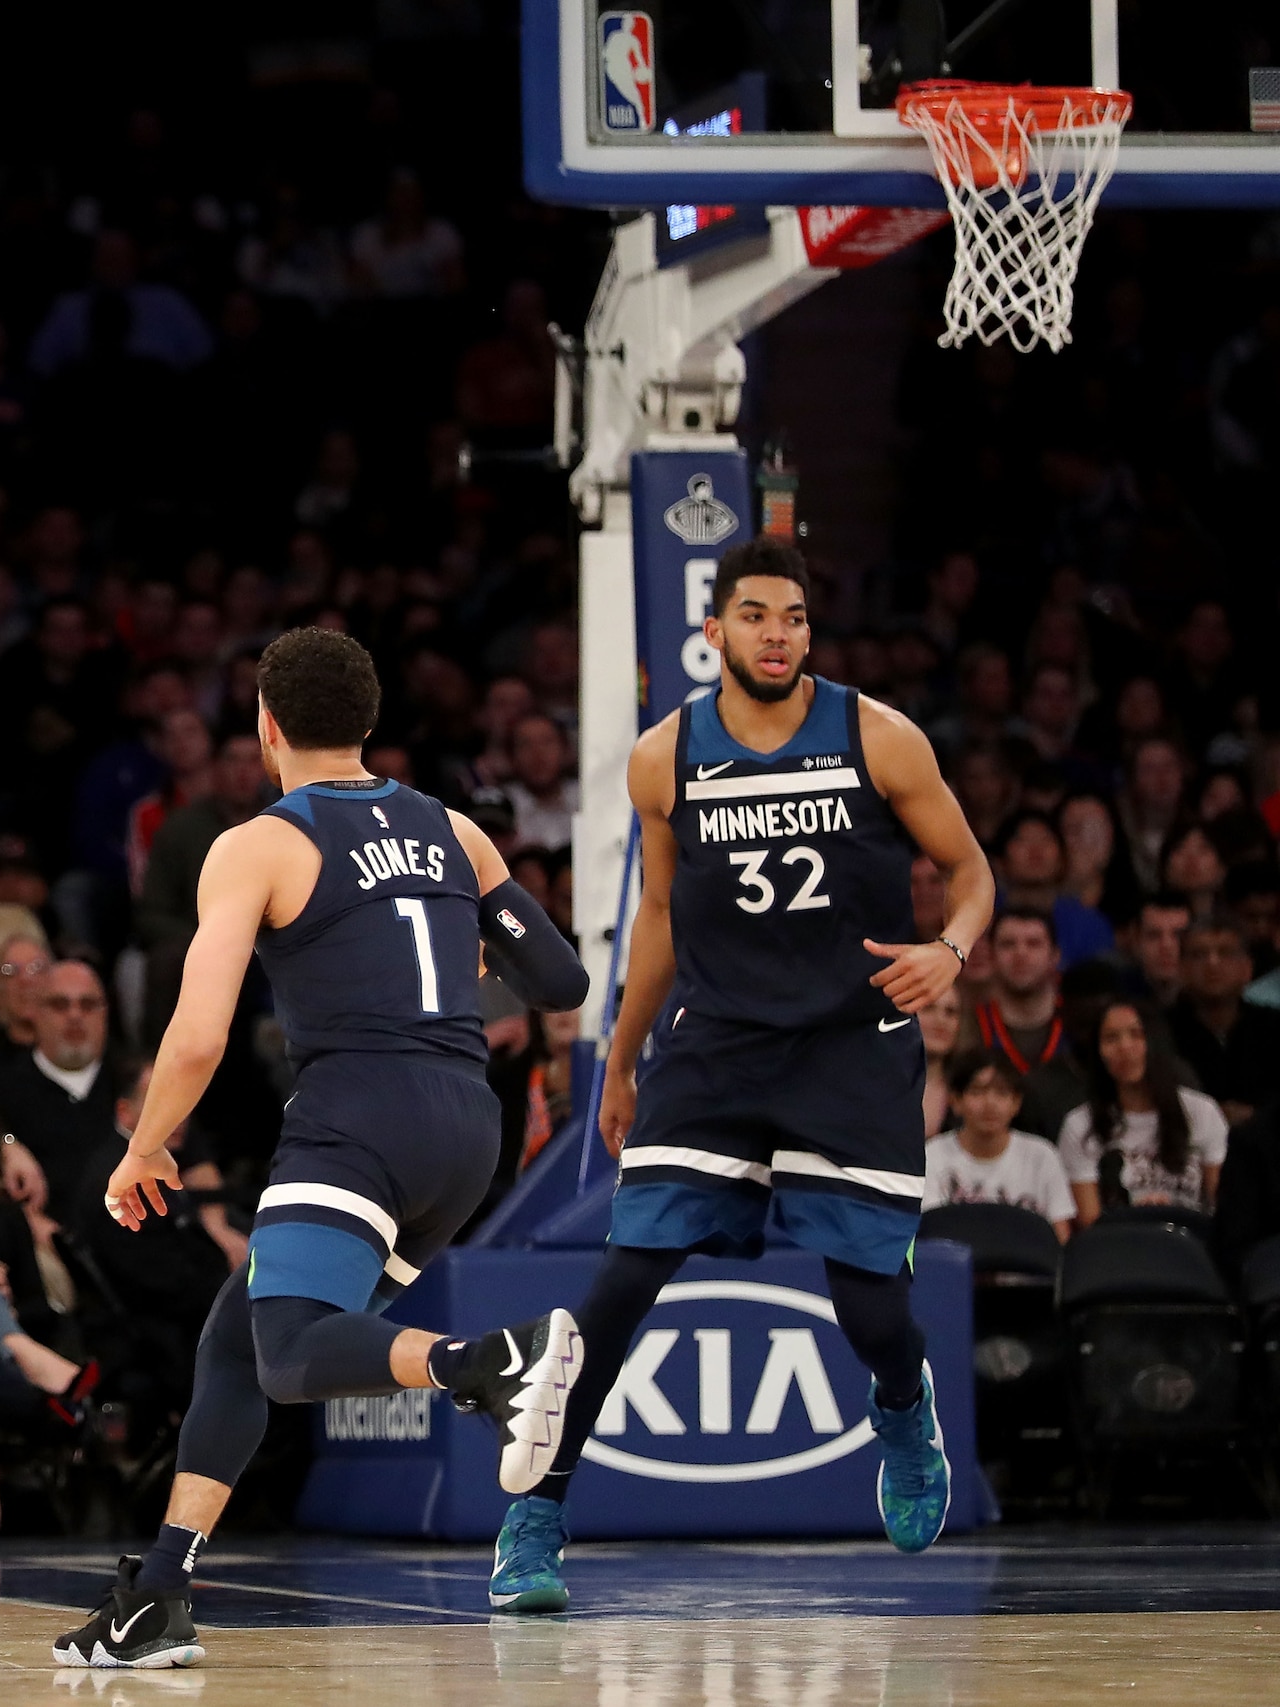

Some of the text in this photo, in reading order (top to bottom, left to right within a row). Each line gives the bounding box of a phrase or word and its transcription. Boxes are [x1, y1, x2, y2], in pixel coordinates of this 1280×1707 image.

[815, 755, 843, 768] fitbit
[698, 796, 853, 843] MINNESOTA
[349, 837, 445, 891] JONES
[728, 845, 831, 914] 32
[391, 896, 440, 1015] 1
[596, 1328, 845, 1437] KIA
